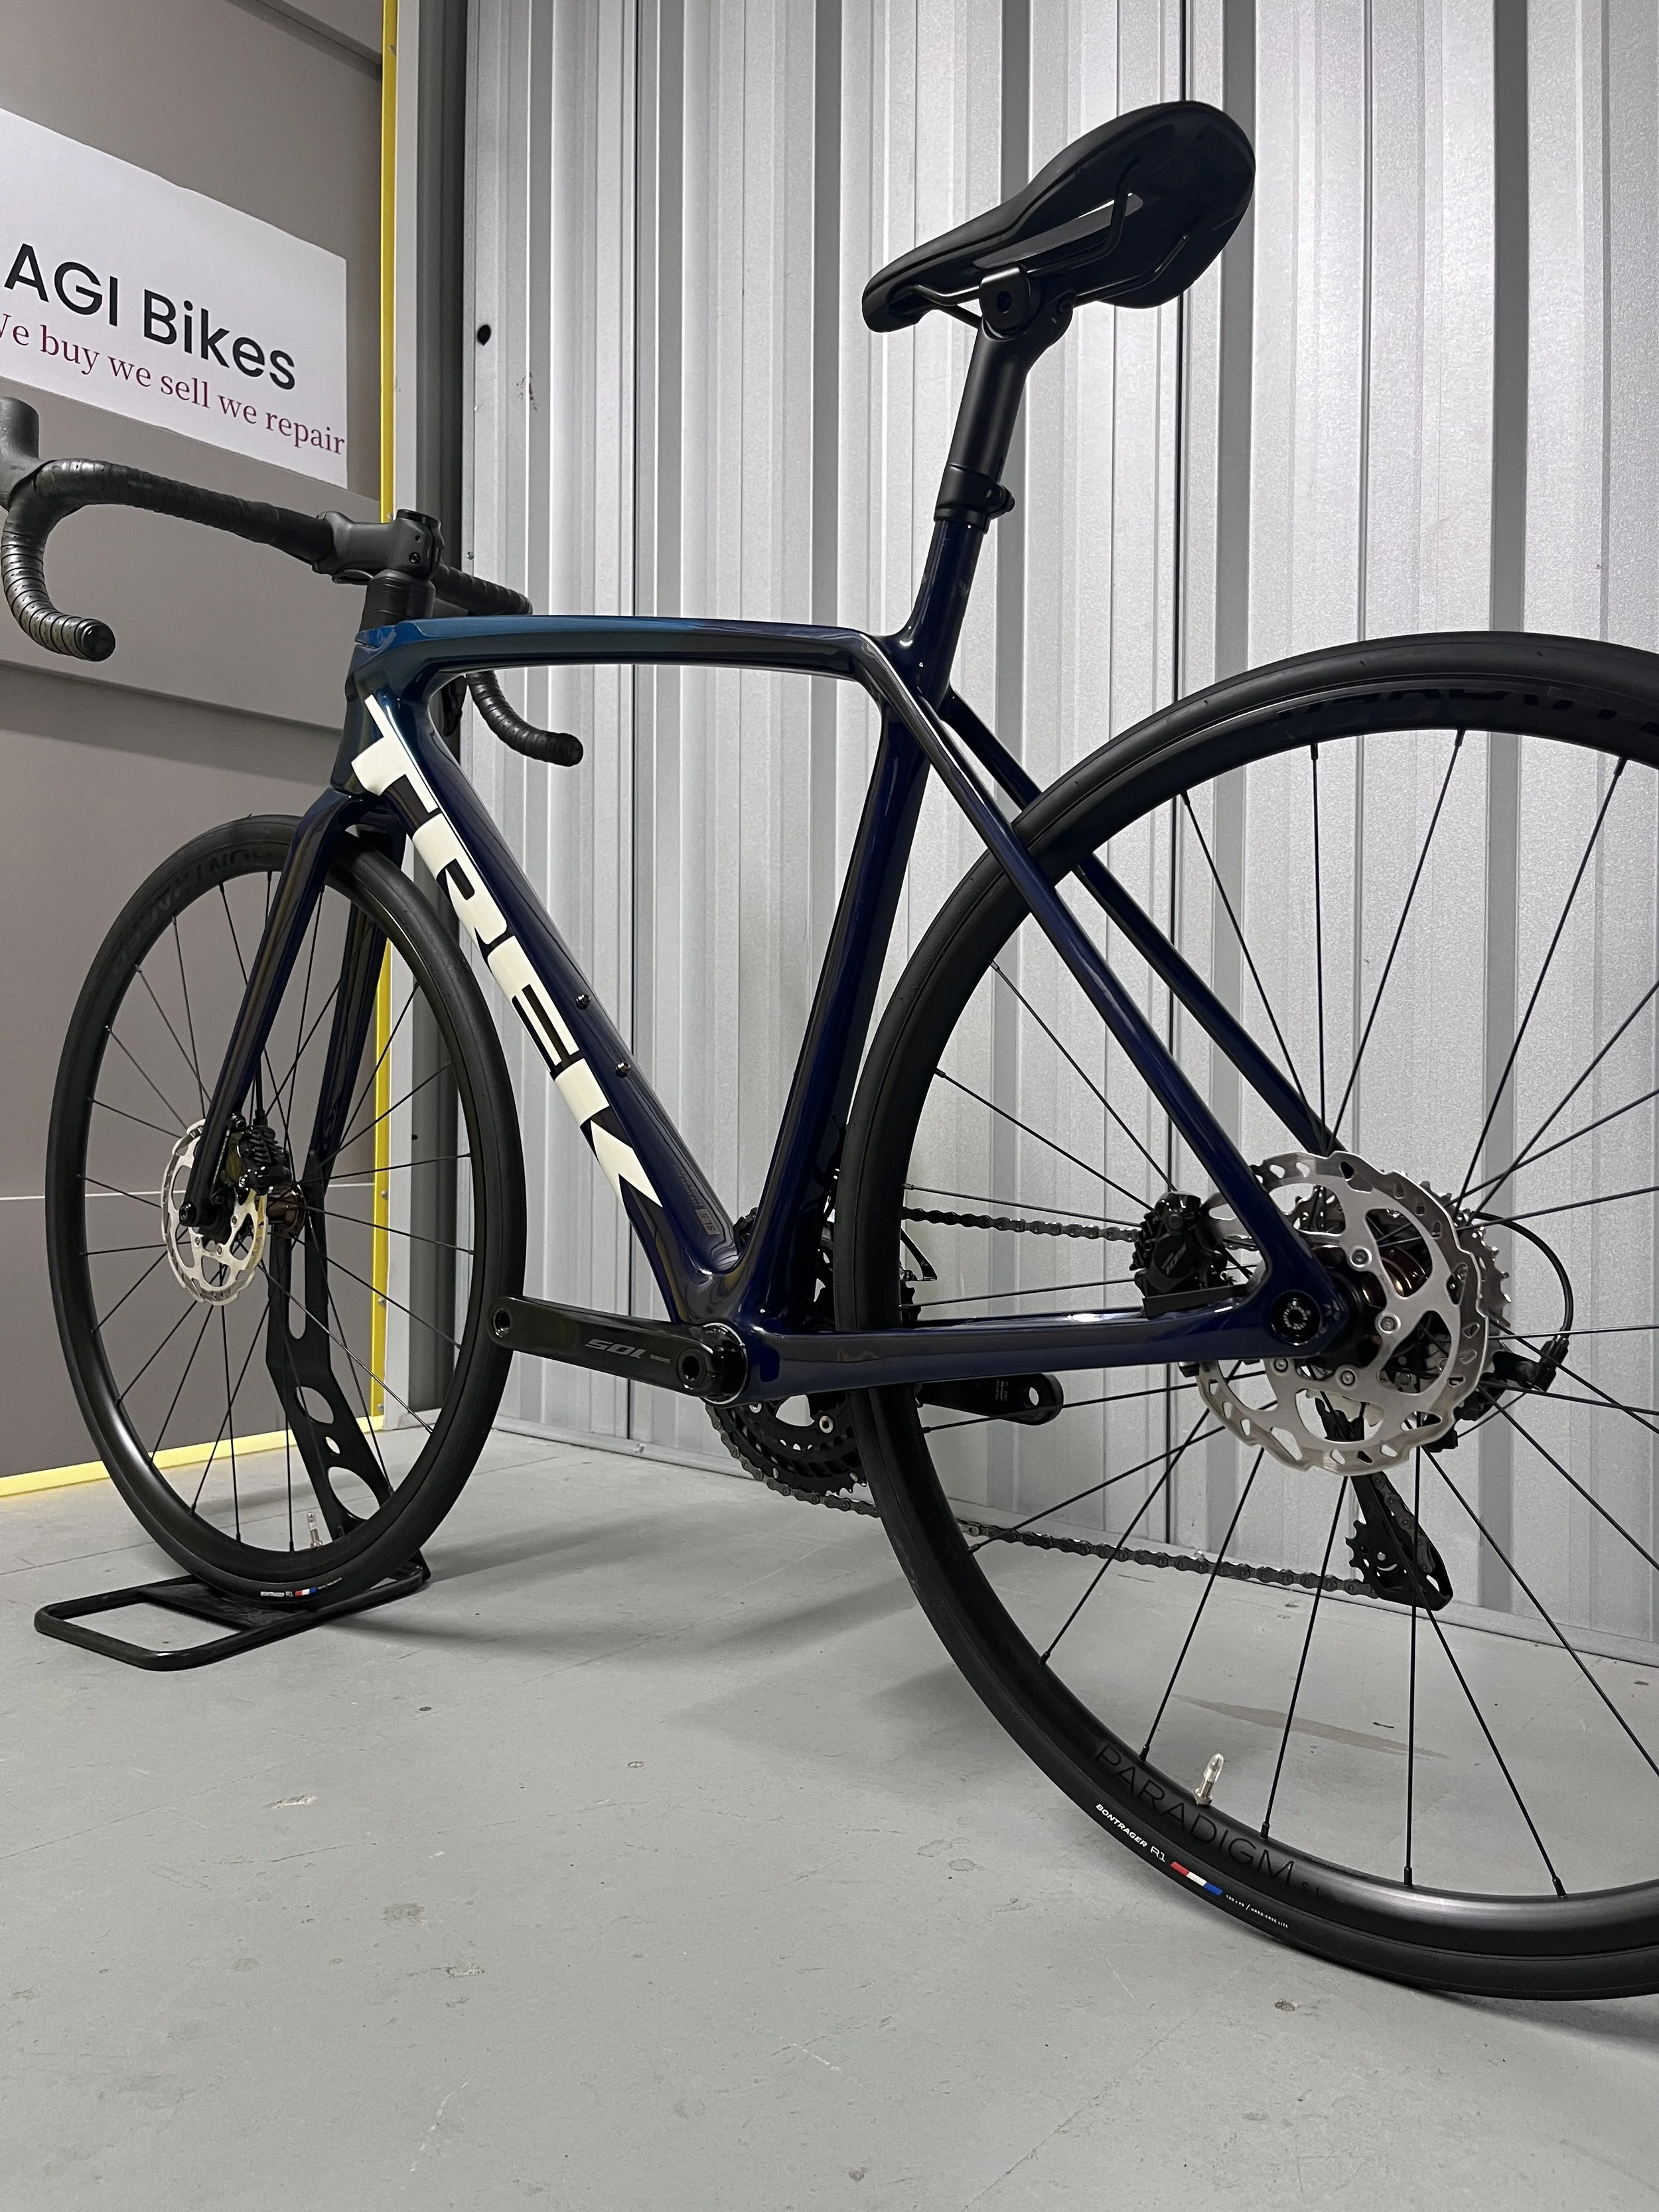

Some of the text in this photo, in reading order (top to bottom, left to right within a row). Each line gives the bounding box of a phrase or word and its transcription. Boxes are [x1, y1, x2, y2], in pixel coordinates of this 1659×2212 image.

[4, 243, 296, 390] AGI Bikes
[40, 325, 100, 376] buy
[108, 356, 152, 387] we
[160, 378, 210, 409] sell
[218, 395, 258, 425] we
[265, 411, 346, 455] repair
[351, 694, 664, 1209] TREK
[585, 1339, 647, 1359] 105
[1096, 1741, 1295, 1886] PARADIGM
[1096, 1803, 1166, 1863] BONTRAGER R1
